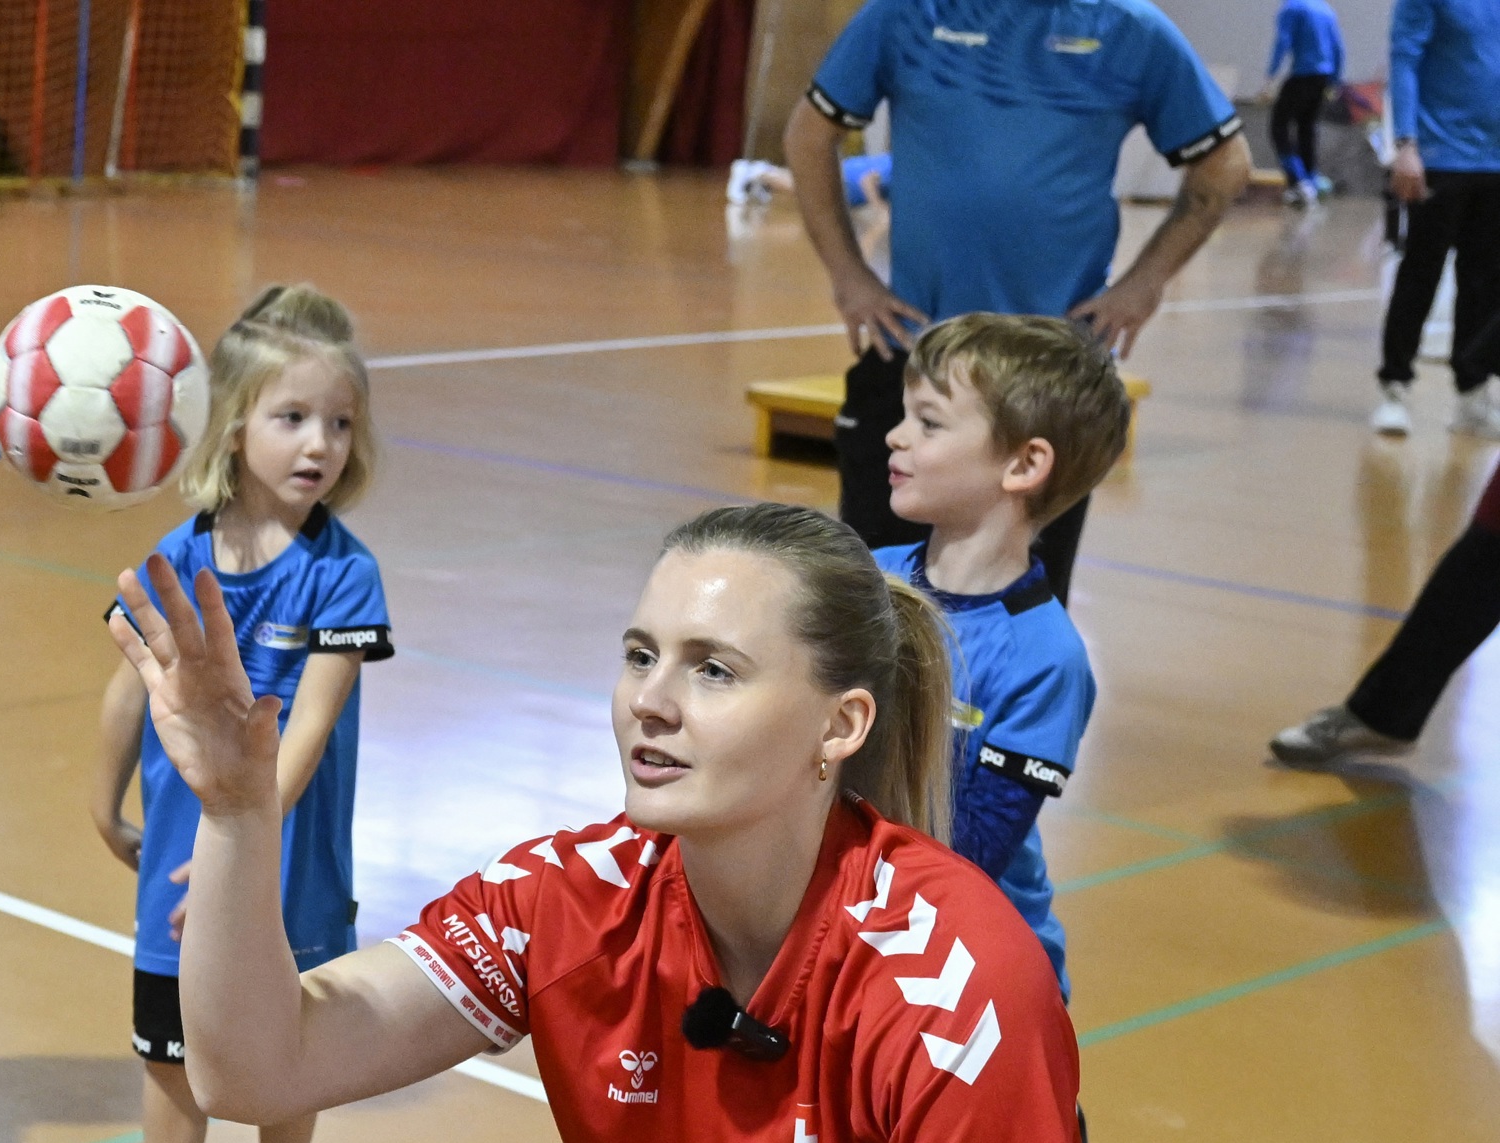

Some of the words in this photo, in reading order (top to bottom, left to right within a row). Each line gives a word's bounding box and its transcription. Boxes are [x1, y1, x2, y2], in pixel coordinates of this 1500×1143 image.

[318, 629, 378, 648] Kempa
[413, 944, 433, 962] HOPP
[607, 1082, 659, 1104] hummel
